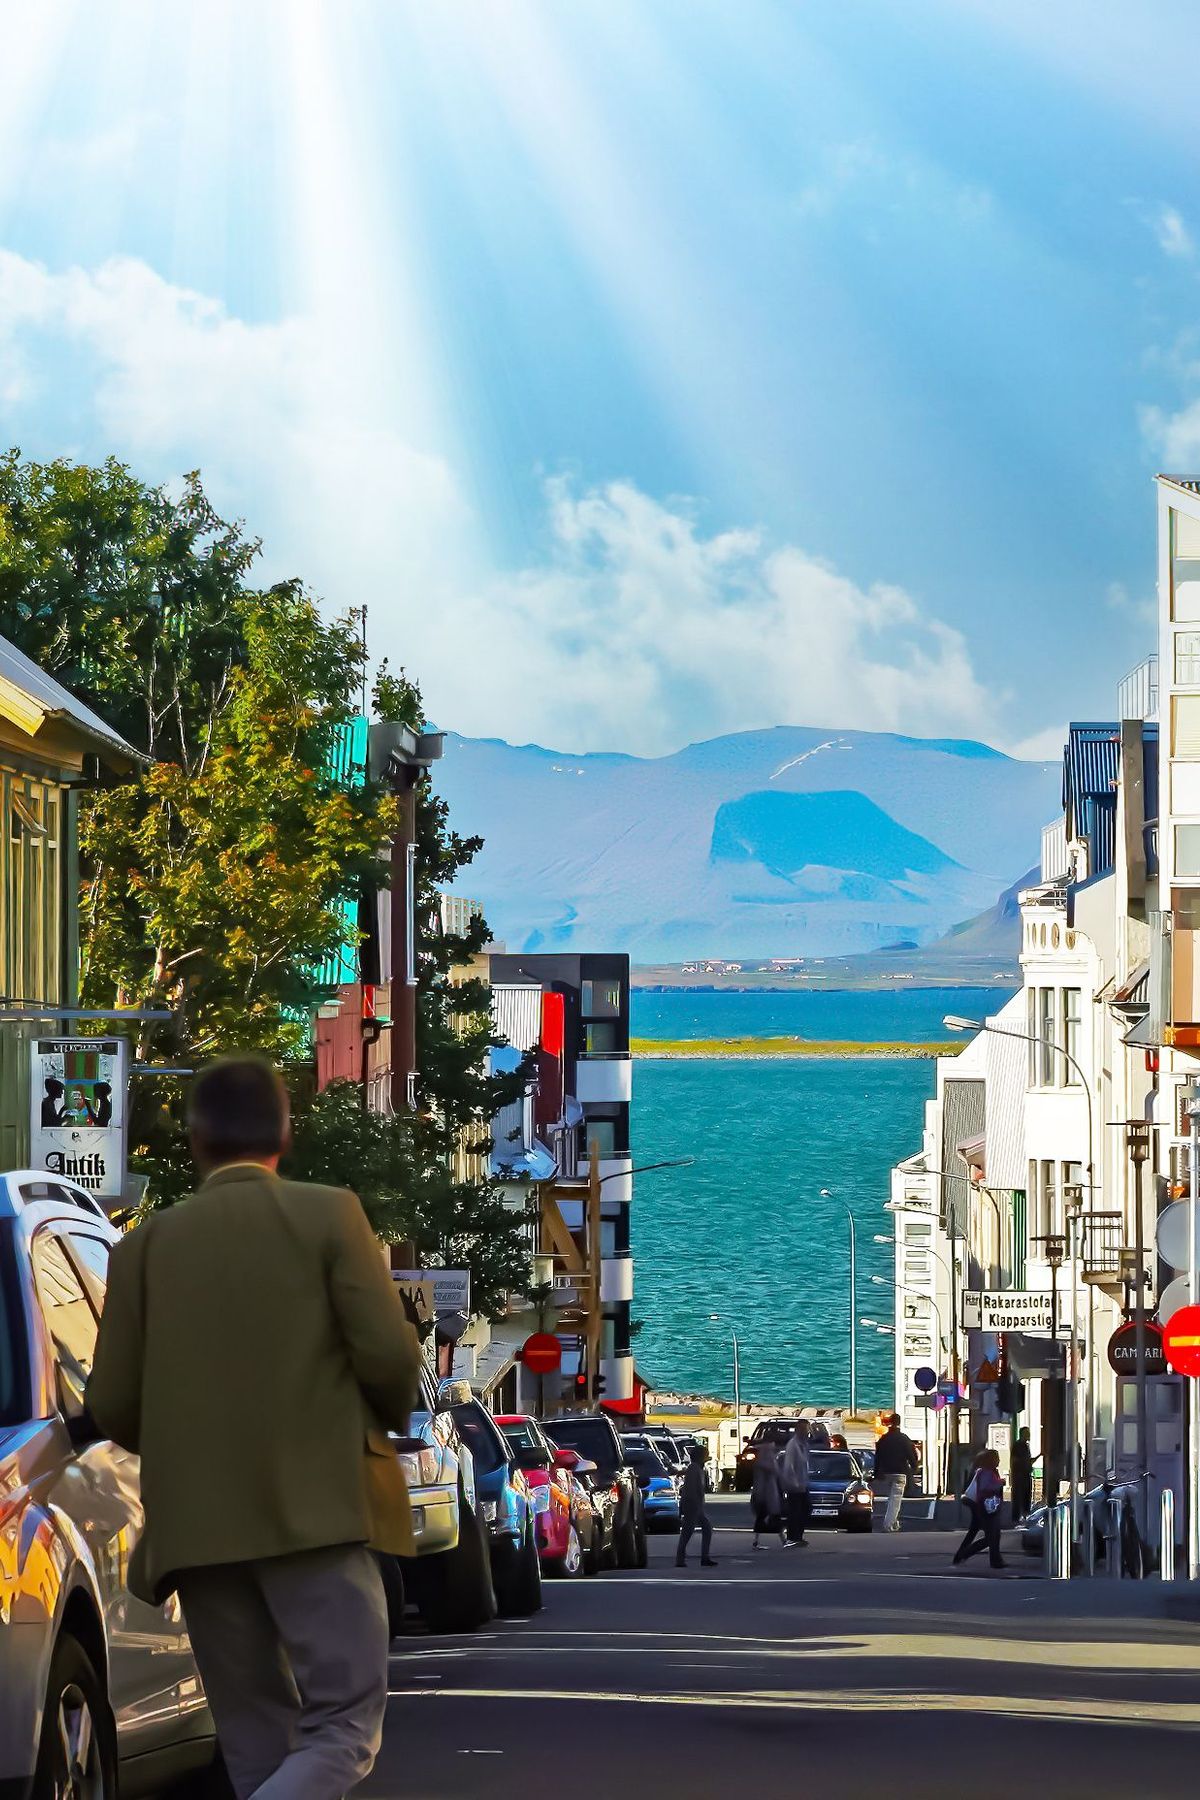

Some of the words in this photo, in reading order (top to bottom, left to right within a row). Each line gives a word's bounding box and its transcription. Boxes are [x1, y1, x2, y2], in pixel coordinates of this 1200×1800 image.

[45, 1151, 105, 1176] Antik
[66, 1177, 103, 1189] unir
[983, 1295, 1053, 1309] Rakarastofa
[1114, 1347, 1162, 1359] CAMARI
